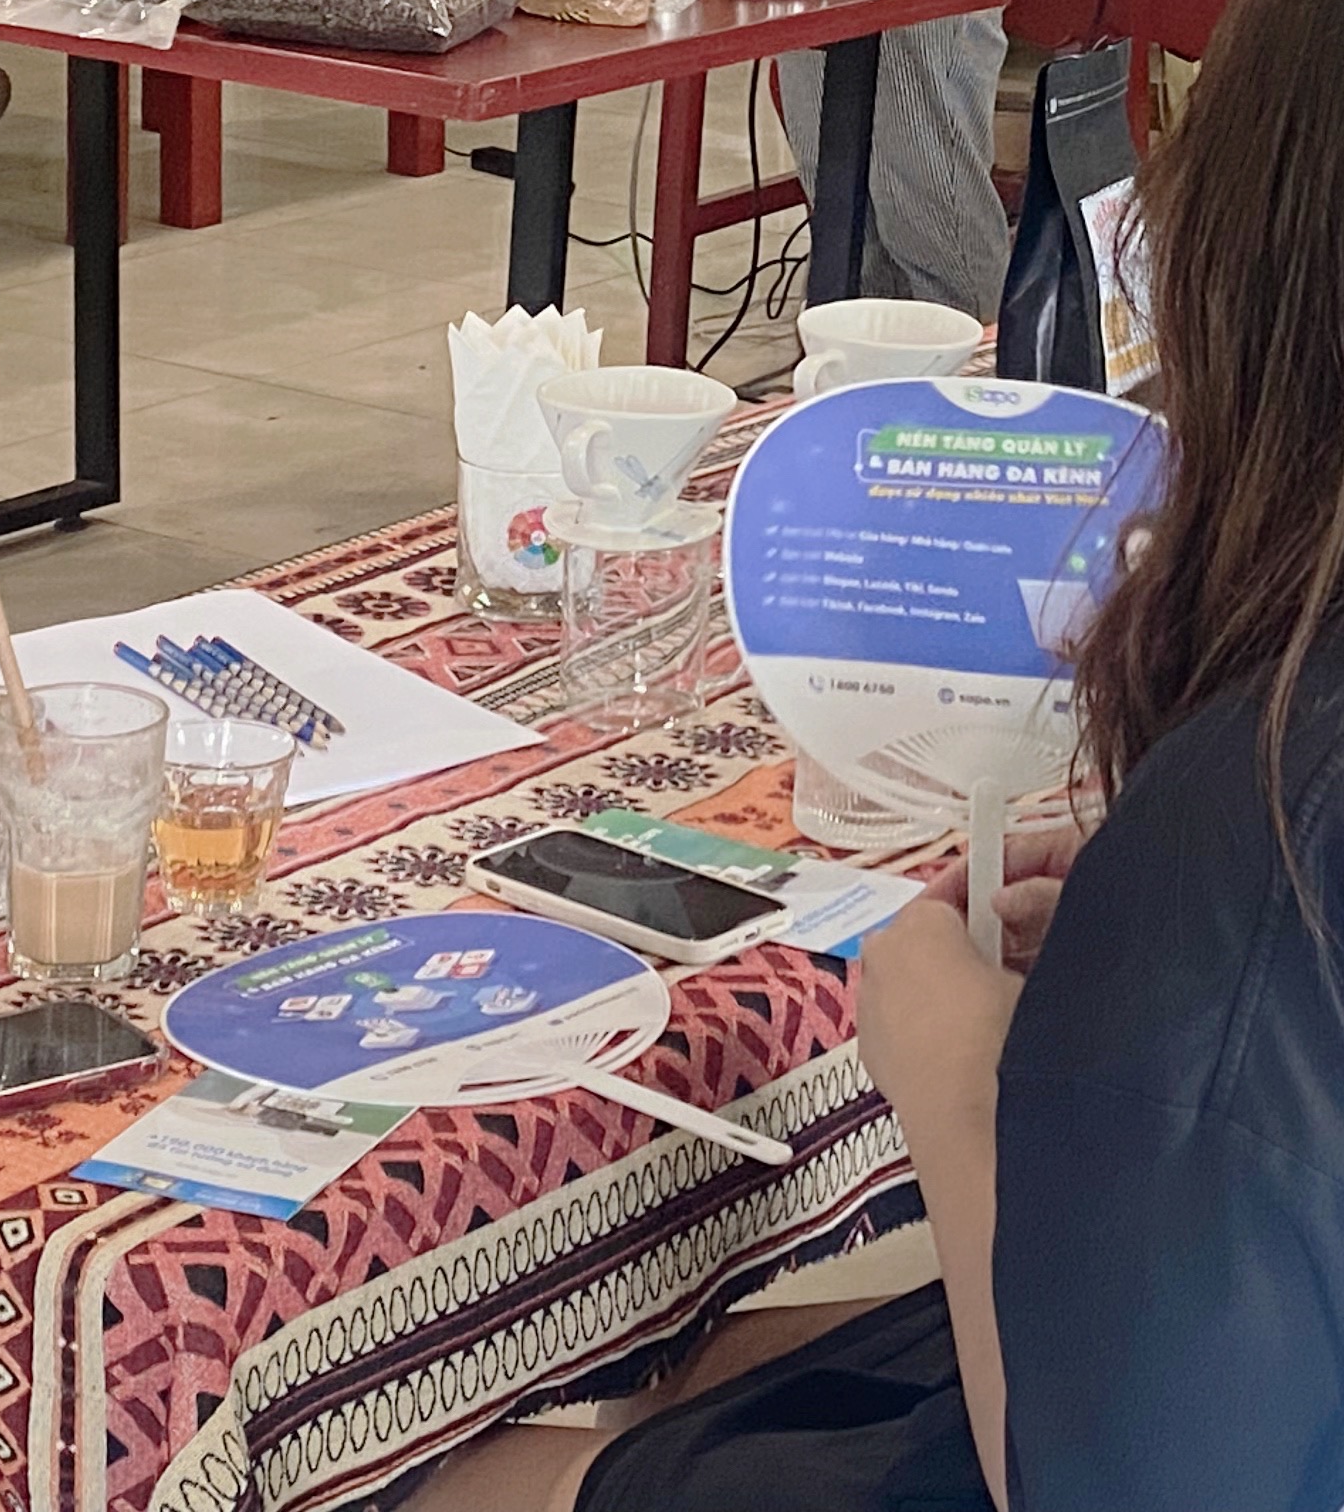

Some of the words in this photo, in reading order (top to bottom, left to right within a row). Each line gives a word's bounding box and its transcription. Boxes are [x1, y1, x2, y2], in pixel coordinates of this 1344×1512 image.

[966, 387, 1020, 405] Sapo
[888, 457, 931, 476] BÁN
[938, 461, 1000, 480] HÀNG
[1006, 465, 1037, 483] ĐA
